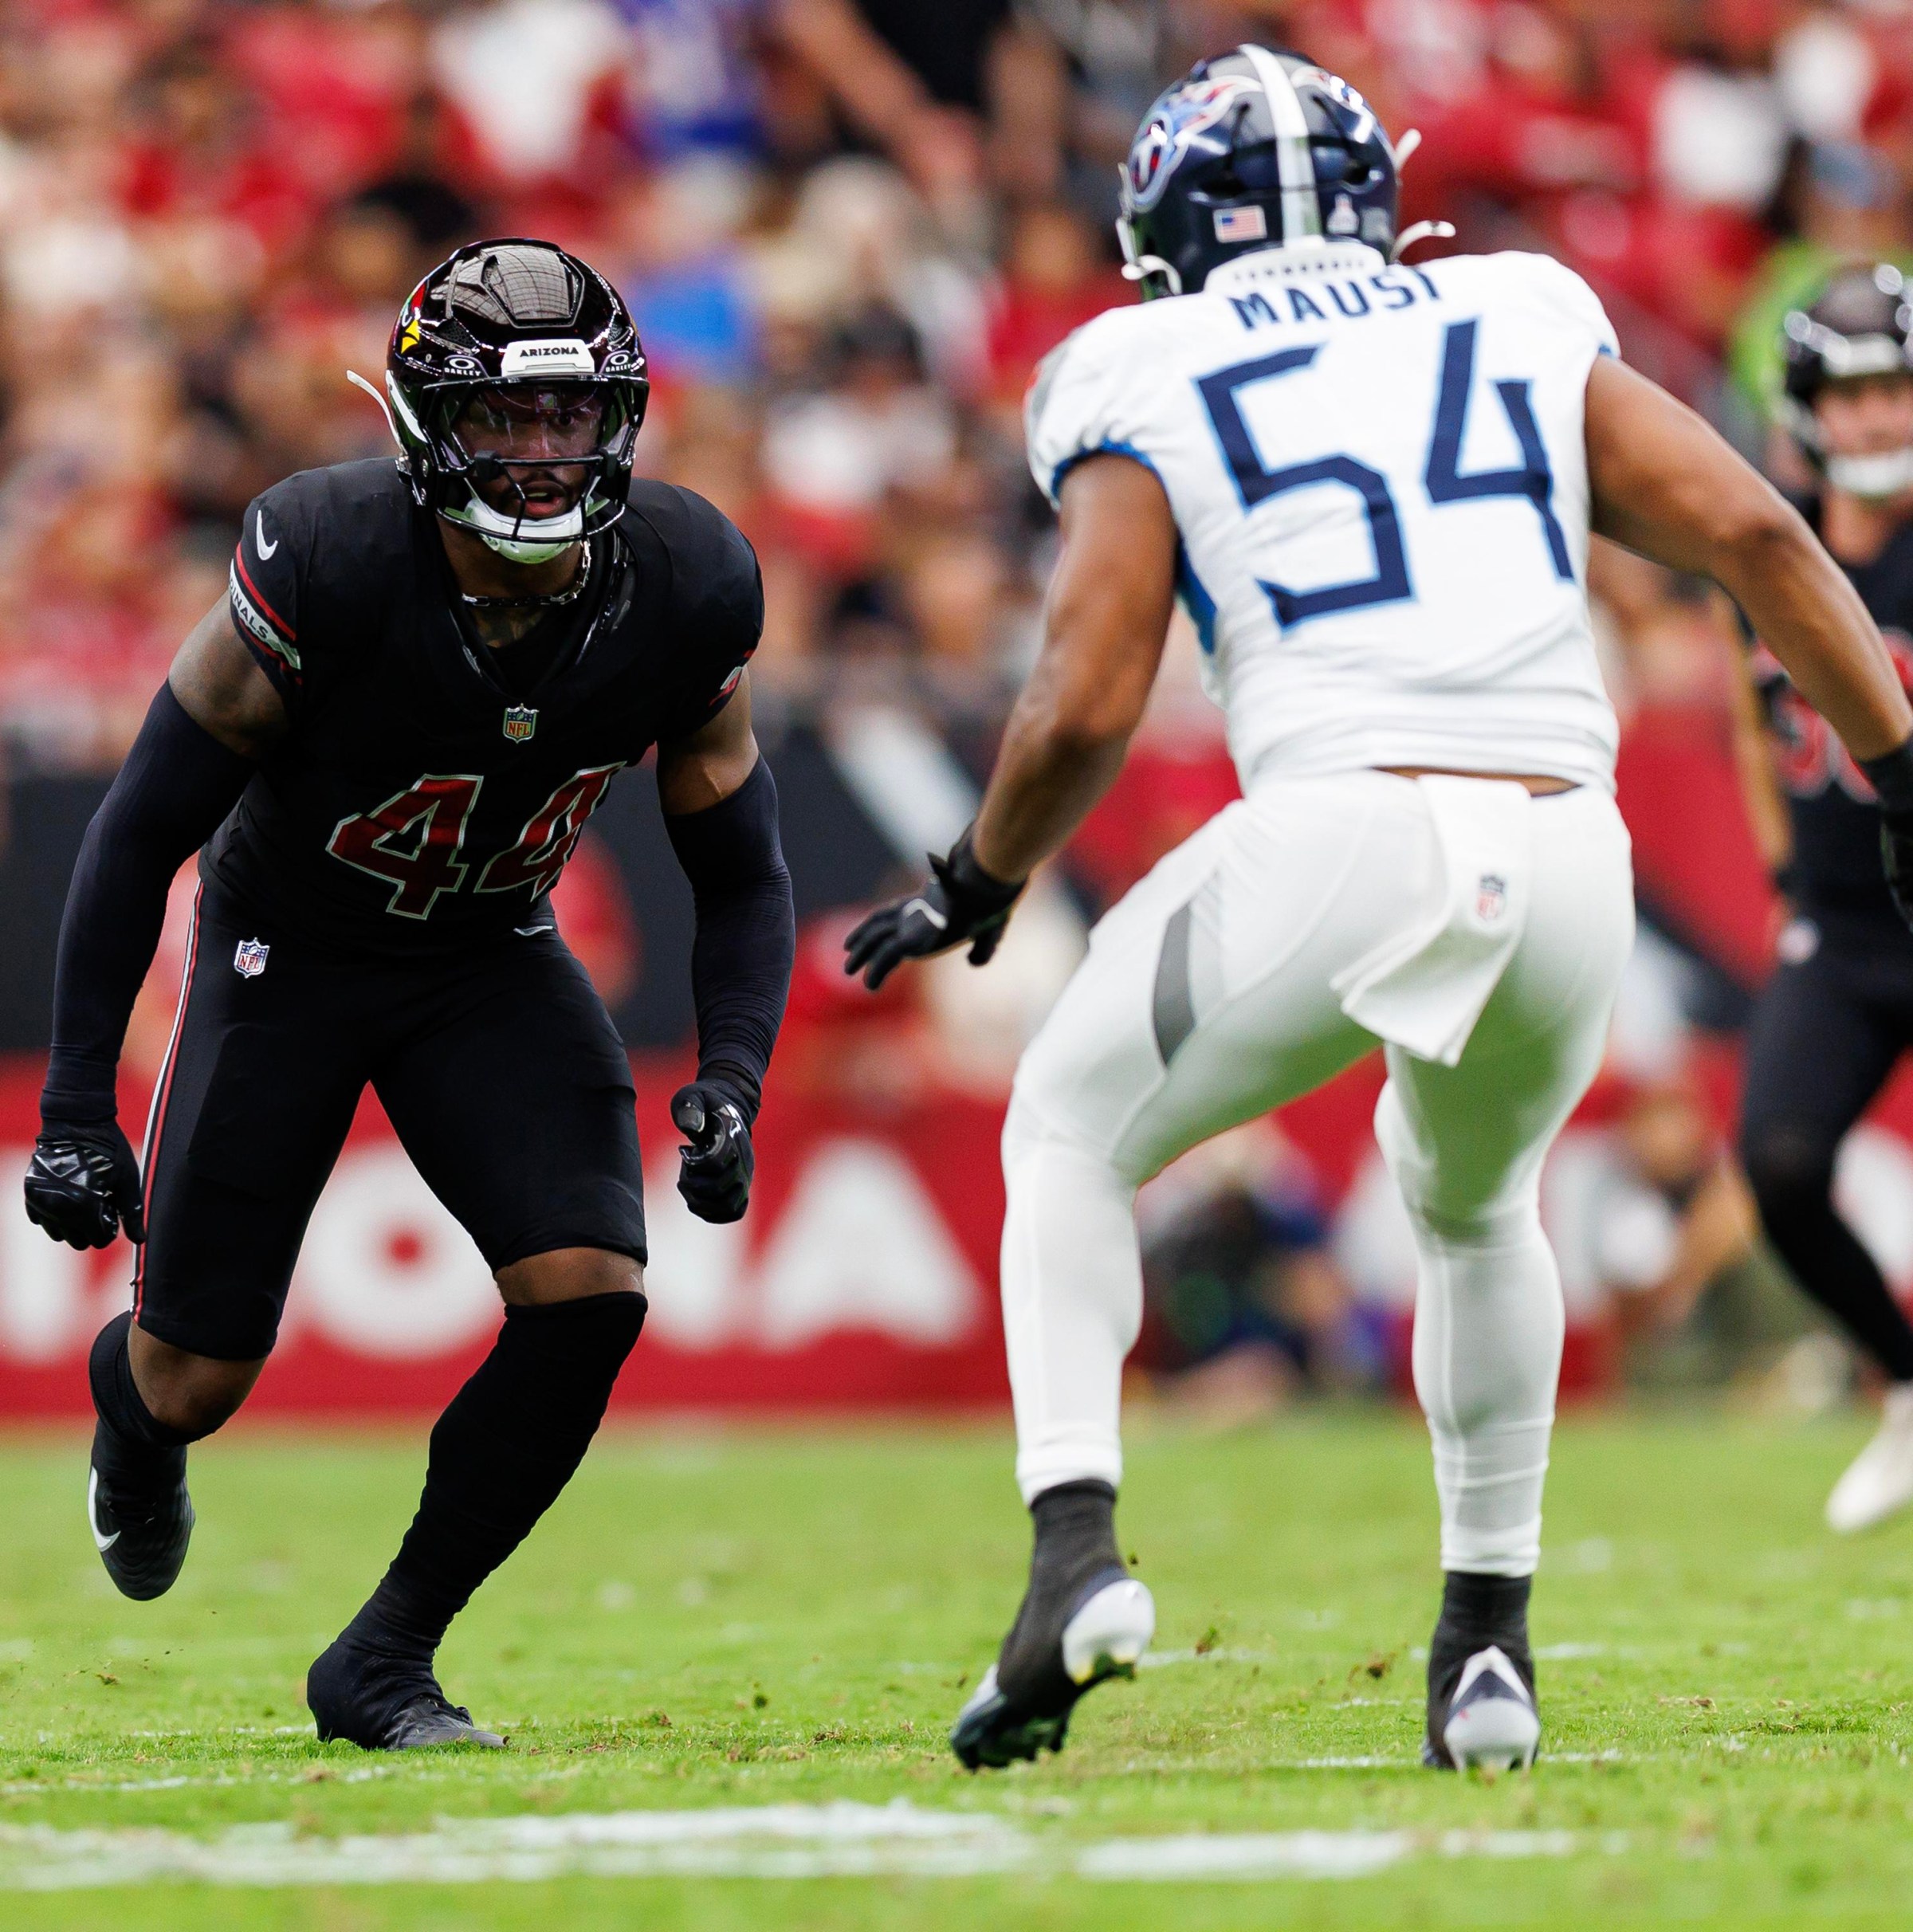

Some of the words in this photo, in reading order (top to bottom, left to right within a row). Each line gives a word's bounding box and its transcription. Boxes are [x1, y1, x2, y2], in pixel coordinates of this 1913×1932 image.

[520, 347, 579, 357] ARIZONA
[444, 367, 481, 376] OAKLEY
[1191, 316, 1578, 633] 54
[508, 721, 531, 737] NFL
[325, 760, 628, 921] 44
[239, 955, 259, 970] NFL
